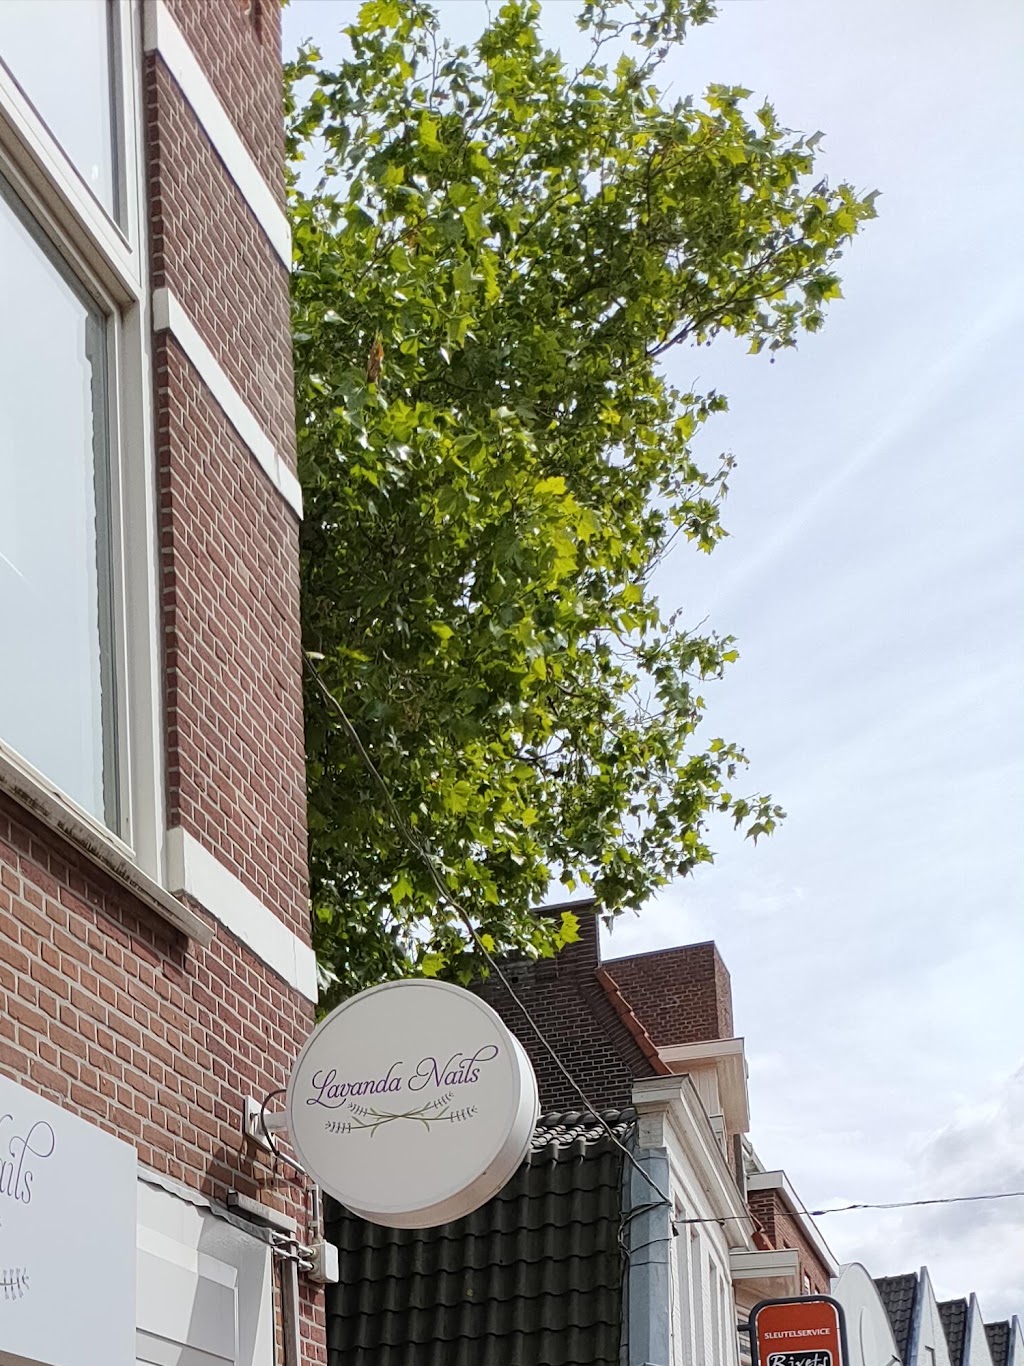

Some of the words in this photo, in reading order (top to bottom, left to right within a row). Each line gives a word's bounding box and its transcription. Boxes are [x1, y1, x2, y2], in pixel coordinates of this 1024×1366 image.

[306, 1061, 403, 1109] Lavanda
[407, 1044, 499, 1092] Nails
[765, 1328, 830, 1339] SLEUTELSERVICE
